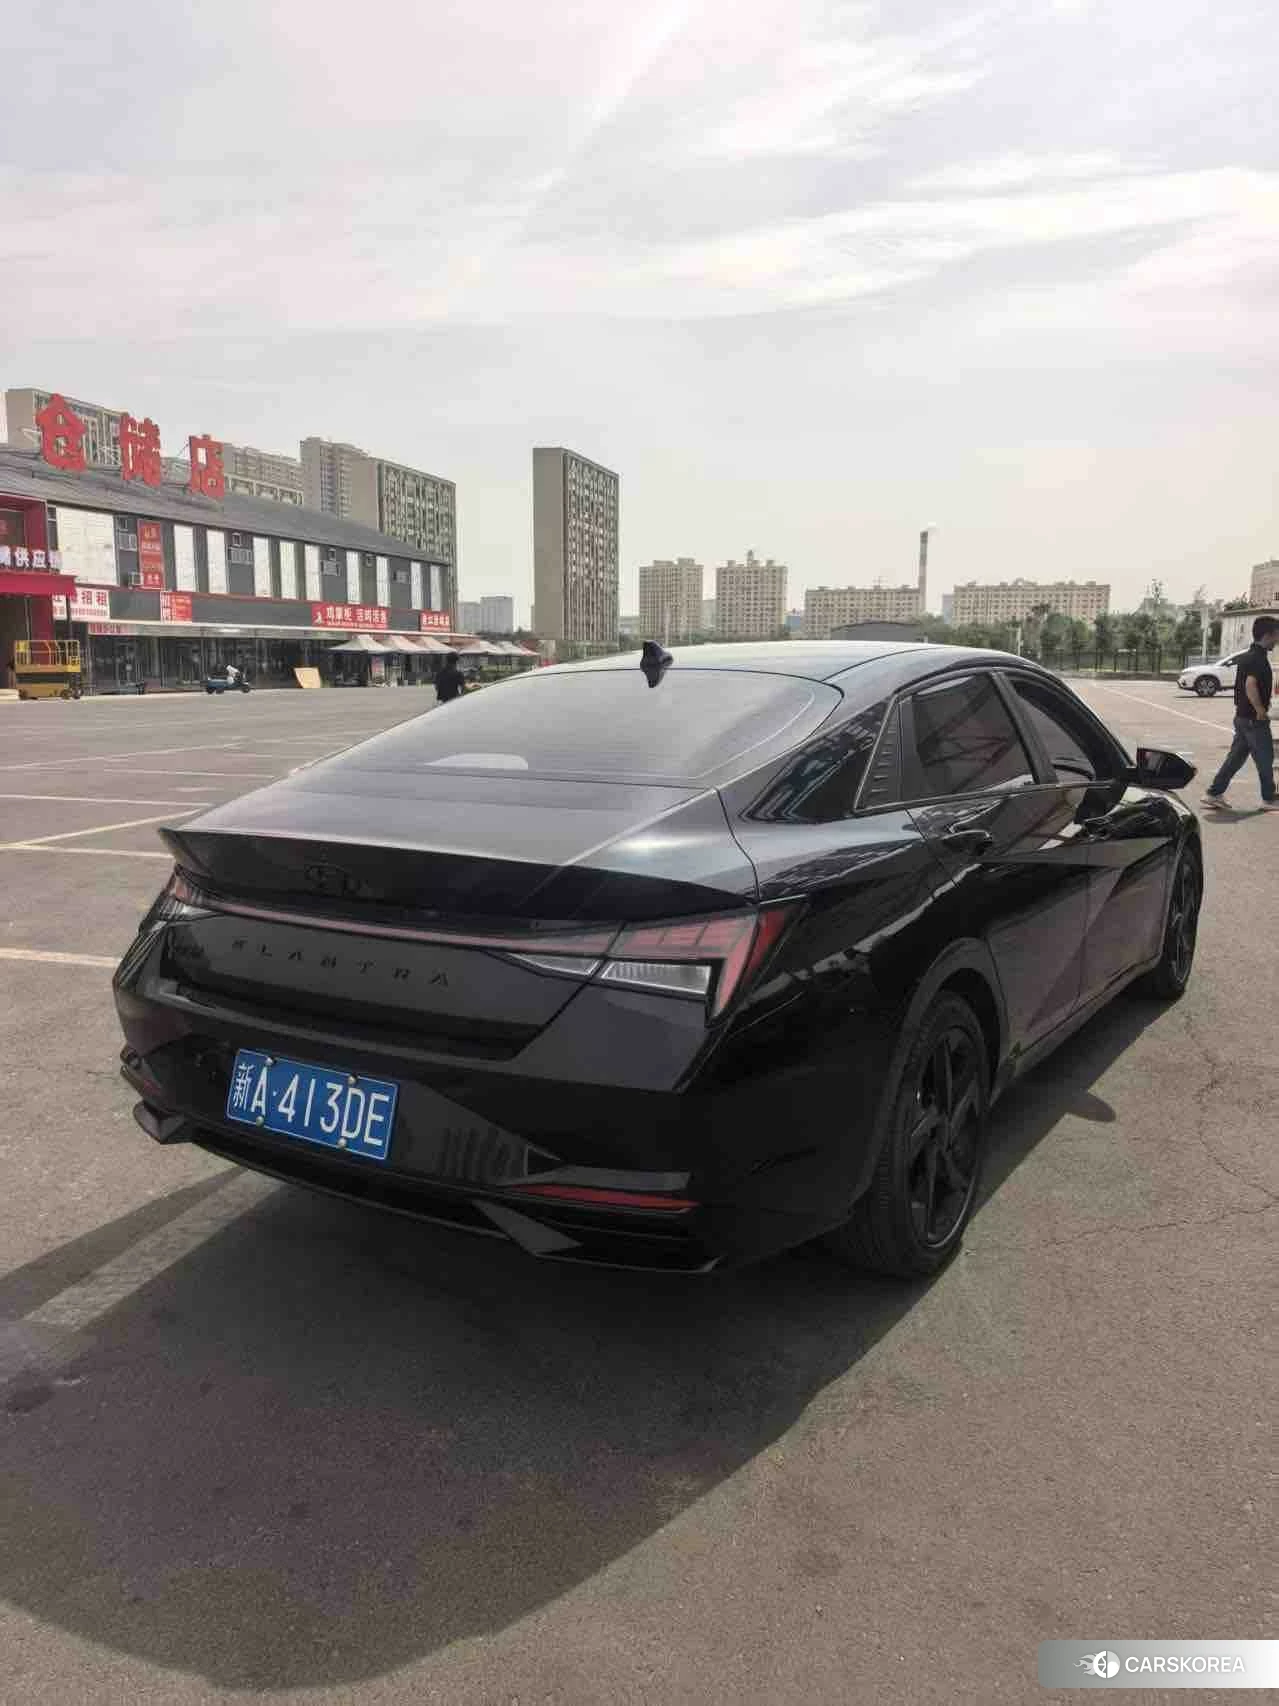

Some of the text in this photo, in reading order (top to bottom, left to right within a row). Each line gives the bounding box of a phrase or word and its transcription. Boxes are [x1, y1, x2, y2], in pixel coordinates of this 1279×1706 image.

[36, 393, 224, 497] 仓储店
[232, 939, 449, 986] ELANTRA
